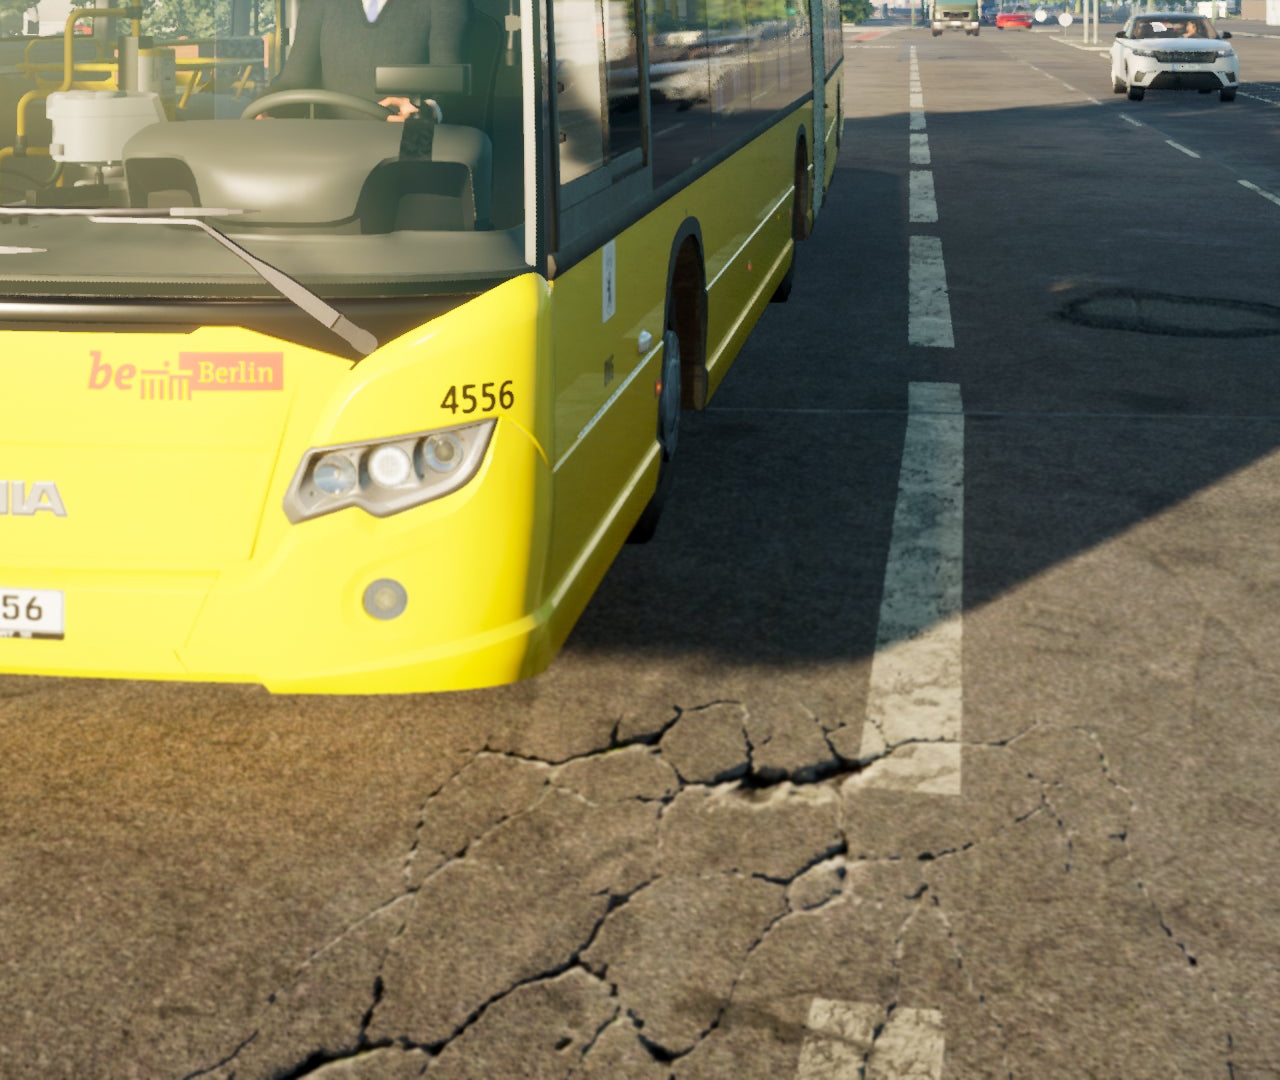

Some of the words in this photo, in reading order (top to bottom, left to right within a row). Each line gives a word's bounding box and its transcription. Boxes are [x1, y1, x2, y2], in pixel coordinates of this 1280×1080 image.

[88, 350, 137, 390] be
[198, 361, 273, 384] Berlin
[440, 380, 515, 415] 4556
